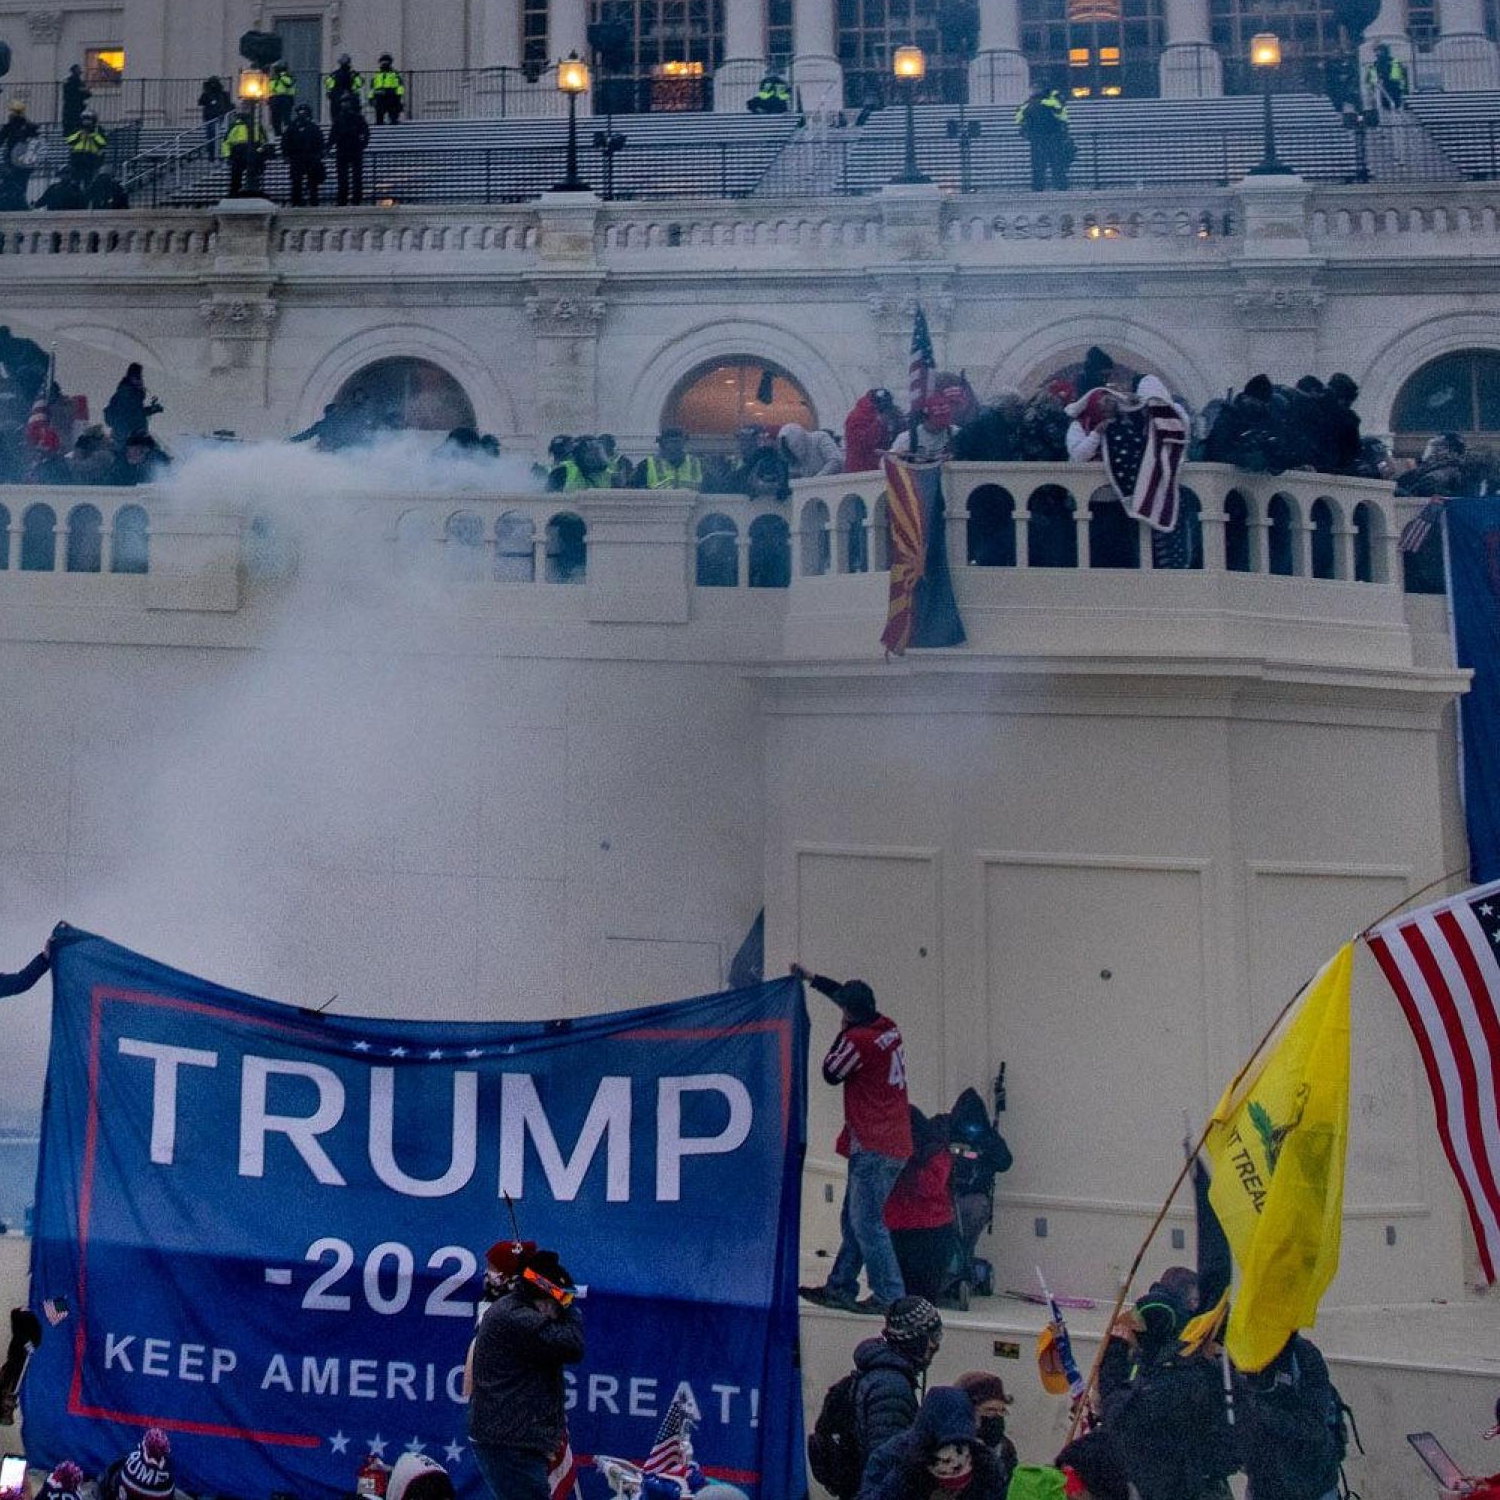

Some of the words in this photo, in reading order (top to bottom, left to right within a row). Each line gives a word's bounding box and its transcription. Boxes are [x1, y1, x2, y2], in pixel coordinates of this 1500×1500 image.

[117, 1036, 754, 1203] TRUMP
[103, 1332, 238, 1384] KEEP
[259, 1353, 471, 1405] AMERIC
[126, 1442, 170, 1487] RUMP
